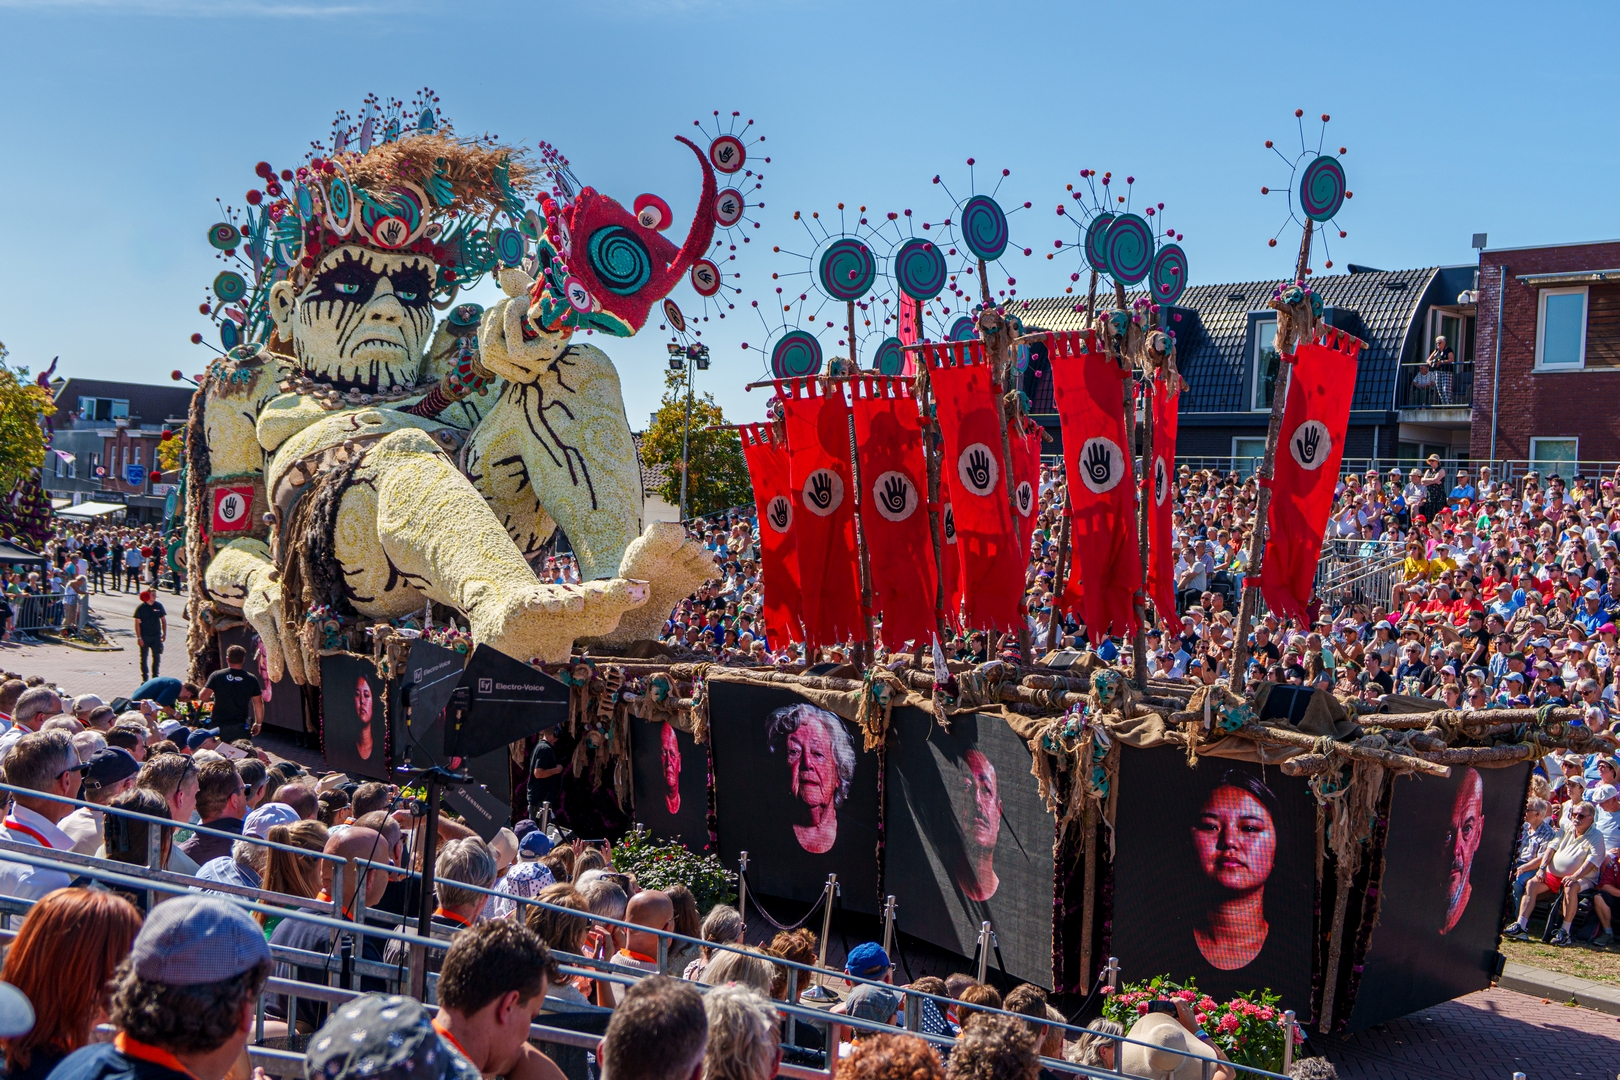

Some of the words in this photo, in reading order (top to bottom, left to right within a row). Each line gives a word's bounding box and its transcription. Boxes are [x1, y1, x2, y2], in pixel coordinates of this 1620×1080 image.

[423, 659, 451, 676] Electro-Voice
[495, 682, 545, 692] Electro-Voice
[464, 793, 493, 821] SENNHEISER
